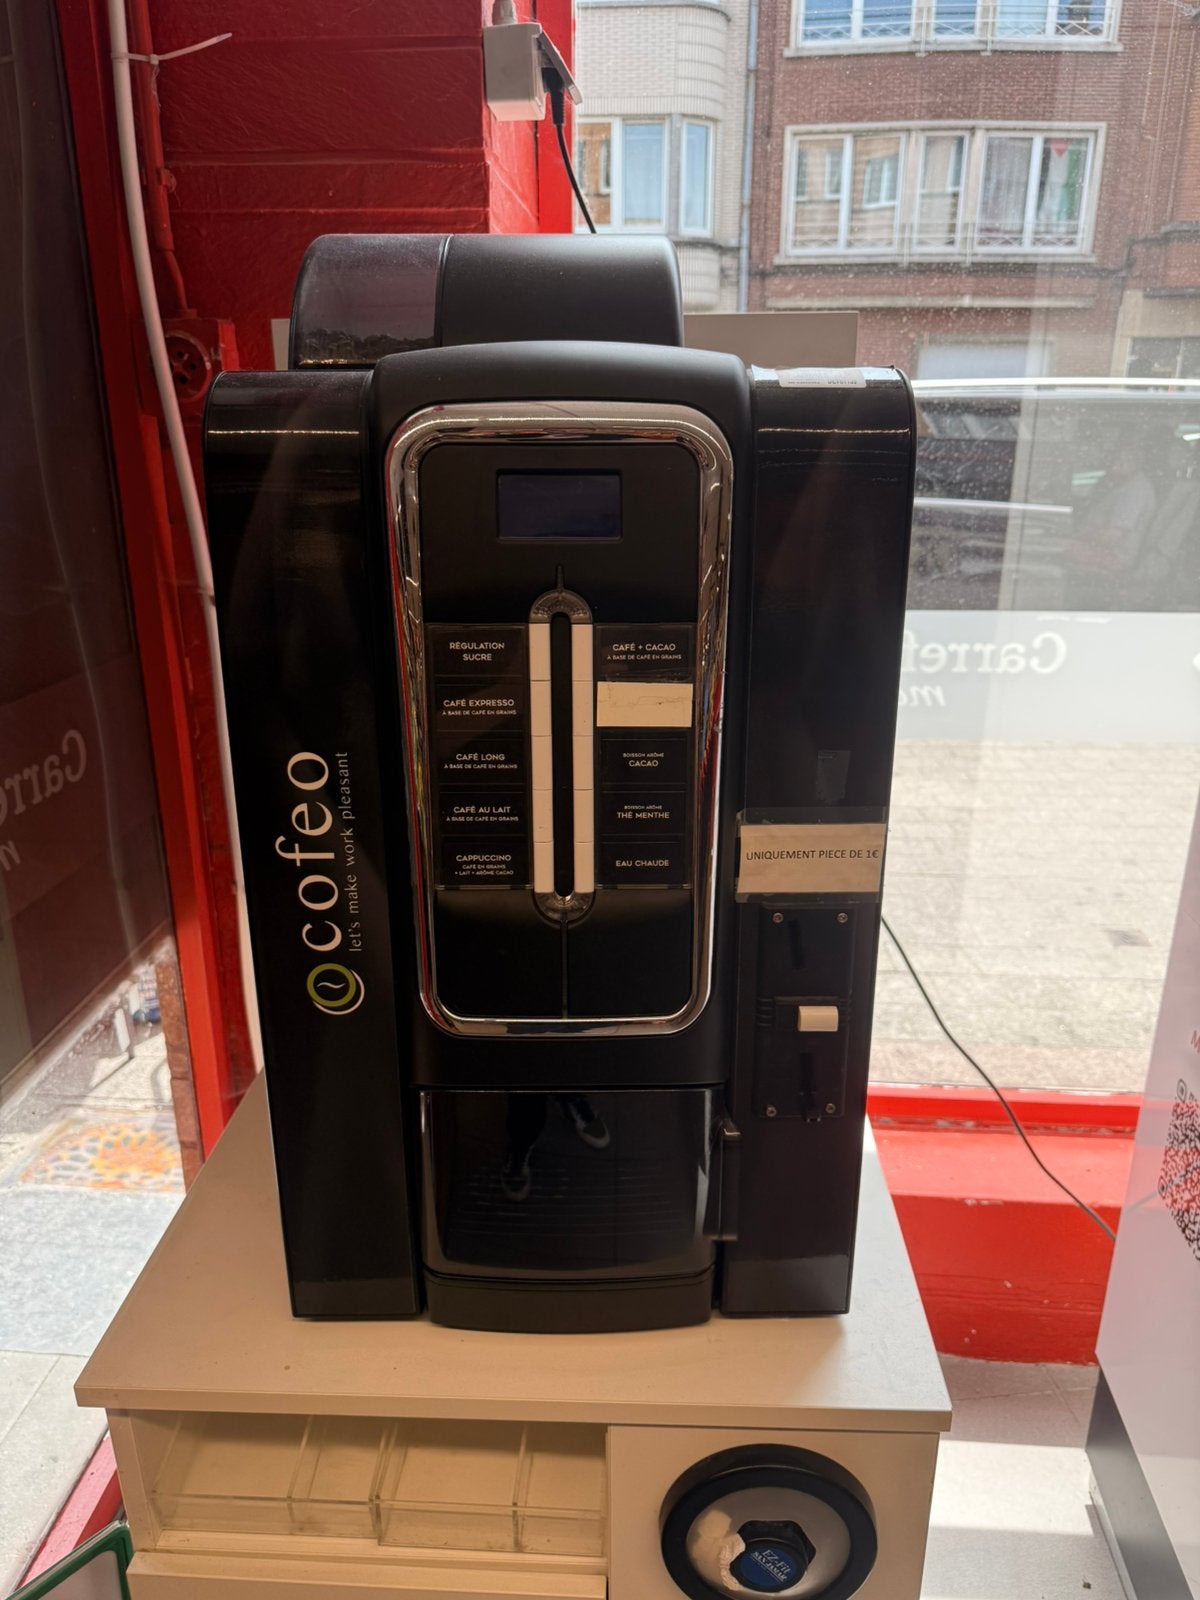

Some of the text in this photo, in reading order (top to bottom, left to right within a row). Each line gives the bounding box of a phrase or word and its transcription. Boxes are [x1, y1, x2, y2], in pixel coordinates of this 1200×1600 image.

[449, 641, 505, 650] RÉGULATION
[612, 642, 636, 651] CAFÉ
[645, 643, 676, 651] CACAO
[462, 653, 493, 661] SUCRE
[443, 698, 515, 707] CAFÉ EXPRESSO
[455, 753, 505, 761] CAFÉ LONG
[453, 805, 511, 814] CAFÉ AU LAIT
[616, 811, 670, 819] THÉ MENTHE
[275, 751, 342, 952] cofeo
[335, 751, 362, 952] let's make work pleasant
[746, 849, 879, 861] UNIQUEMENT PIECE DE 1€
[456, 854, 512, 862] CAPPUCCINO
[635, 859, 670, 867] CHAUDE
